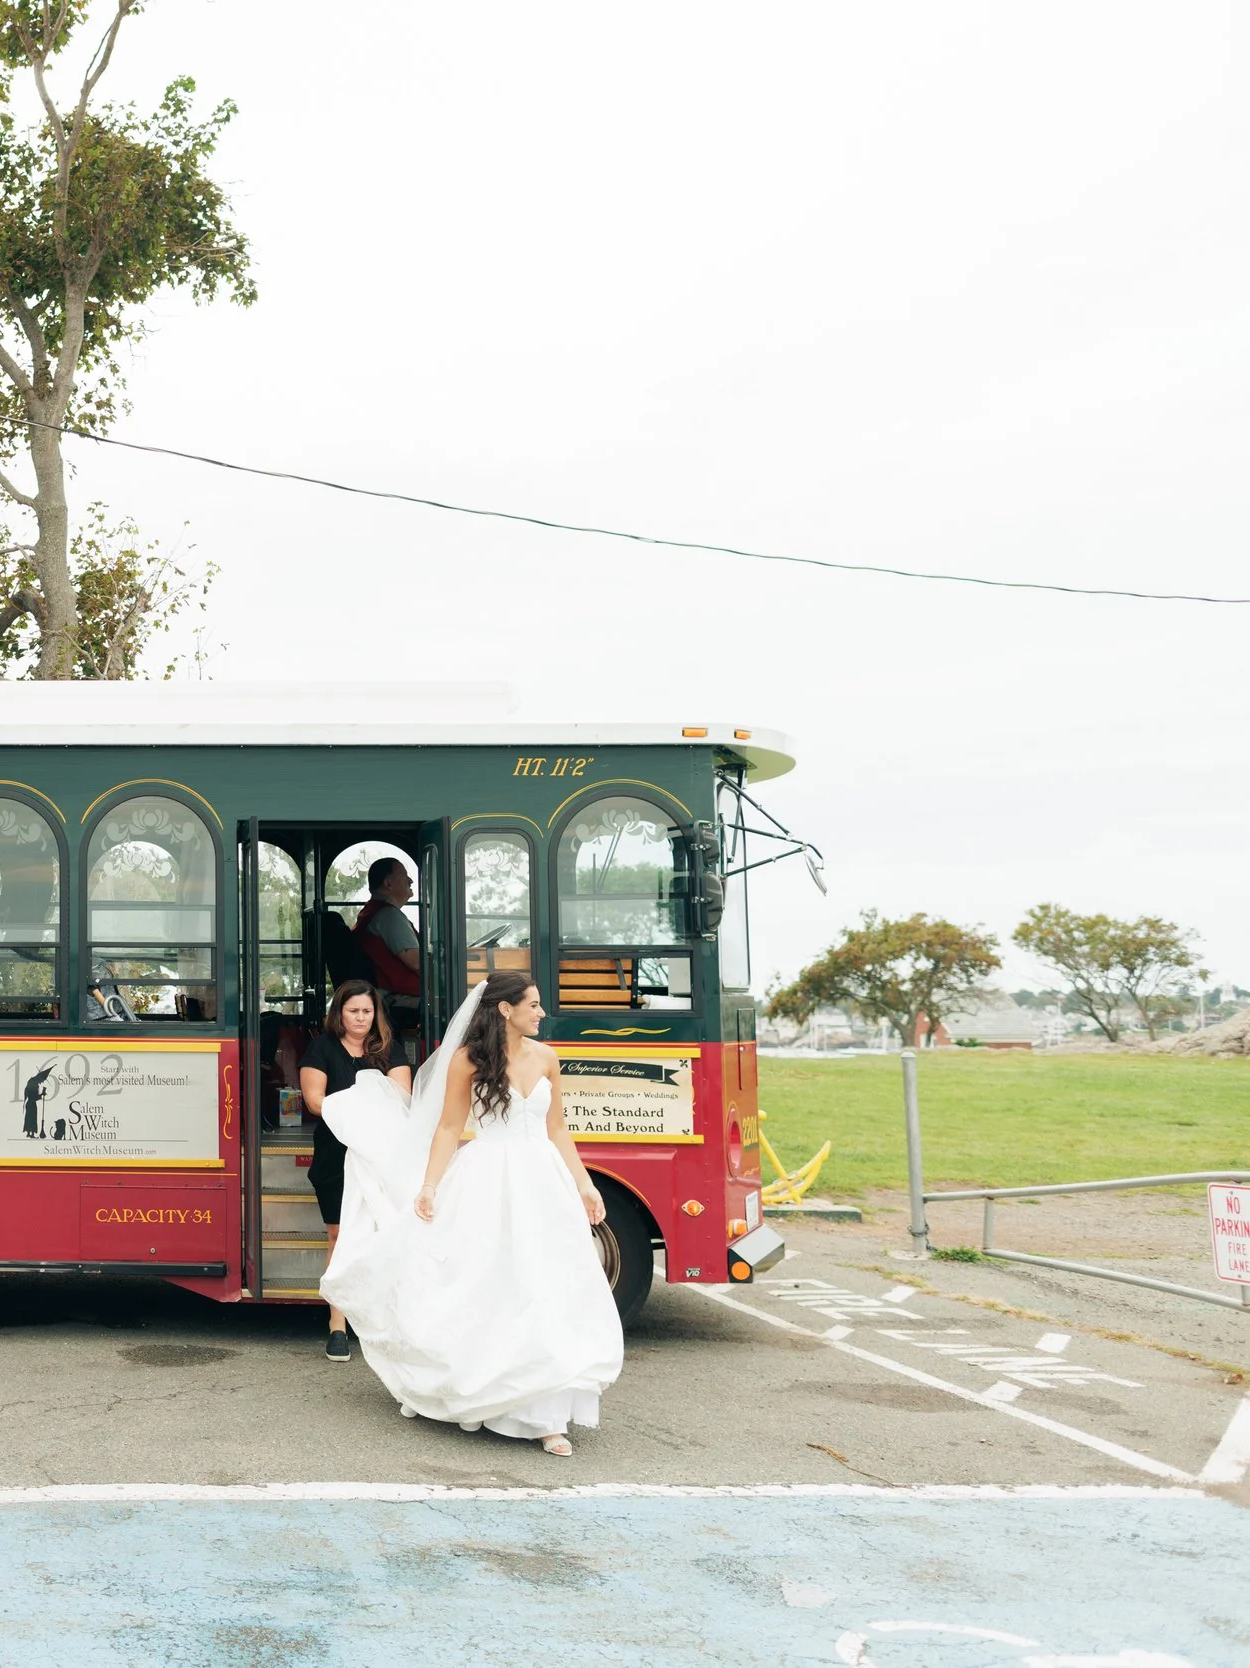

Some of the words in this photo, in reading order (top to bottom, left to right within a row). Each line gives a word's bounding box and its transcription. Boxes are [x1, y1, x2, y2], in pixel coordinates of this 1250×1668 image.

[512, 757, 547, 776] HT.
[100, 1064, 121, 1074] Start
[121, 1064, 140, 1074] with
[567, 1061, 609, 1075] Superior
[609, 1064, 646, 1078] Service
[57, 1073, 91, 1086] Salem's
[92, 1074, 114, 1086] most
[115, 1074, 146, 1086] visited
[146, 1074, 190, 1087] Museum!
[579, 1090, 606, 1098] Private
[607, 1091, 635, 1100] Groups
[643, 1091, 679, 1100] Weddings
[68, 1100, 105, 1125] Salem
[572, 1105, 598, 1117] The
[602, 1105, 665, 1118] Standard
[82, 1114, 120, 1132] Witch
[584, 1121, 611, 1132] And
[616, 1122, 665, 1135] Beyond
[68, 1124, 118, 1142] Museum
[43, 1144, 157, 1156] SalemWitchMuseum.com
[1225, 1195, 1242, 1215] NO
[95, 1208, 190, 1224] CAPACITY
[192, 1208, 213, 1225] 34
[1214, 1217, 1250, 1239] PARKIN
[1228, 1241, 1248, 1256] FIRE
[1229, 1258, 1250, 1274] LANE
[751, 1278, 926, 1321] FIRE
[874, 1328, 1146, 1389] LANE
